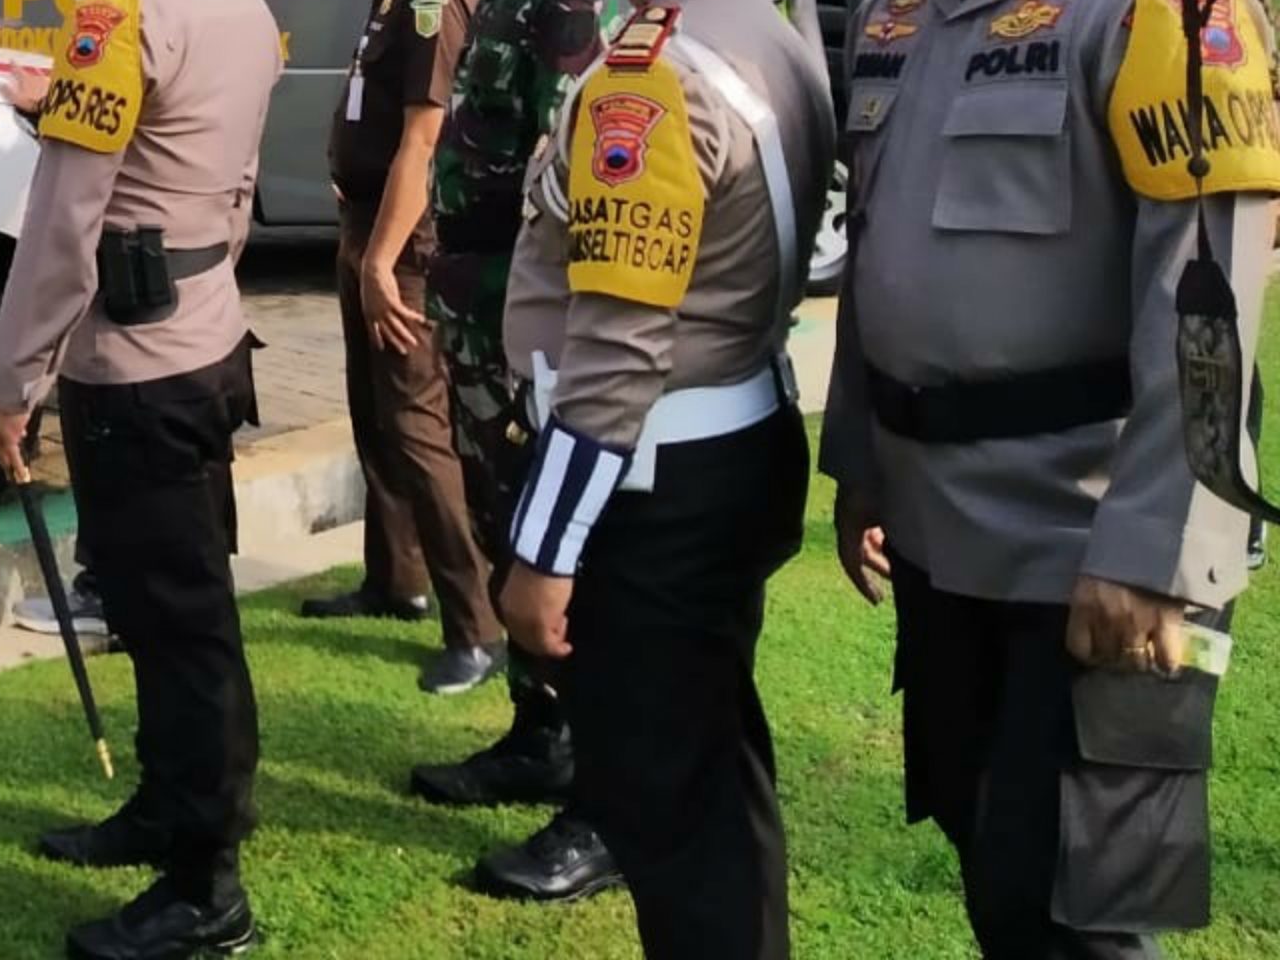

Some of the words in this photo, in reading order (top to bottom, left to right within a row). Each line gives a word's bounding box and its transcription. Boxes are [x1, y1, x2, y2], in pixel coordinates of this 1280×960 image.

[965, 40, 1061, 82] POLRI
[79, 86, 128, 136] RES
[570, 195, 693, 239] ASATGAS
